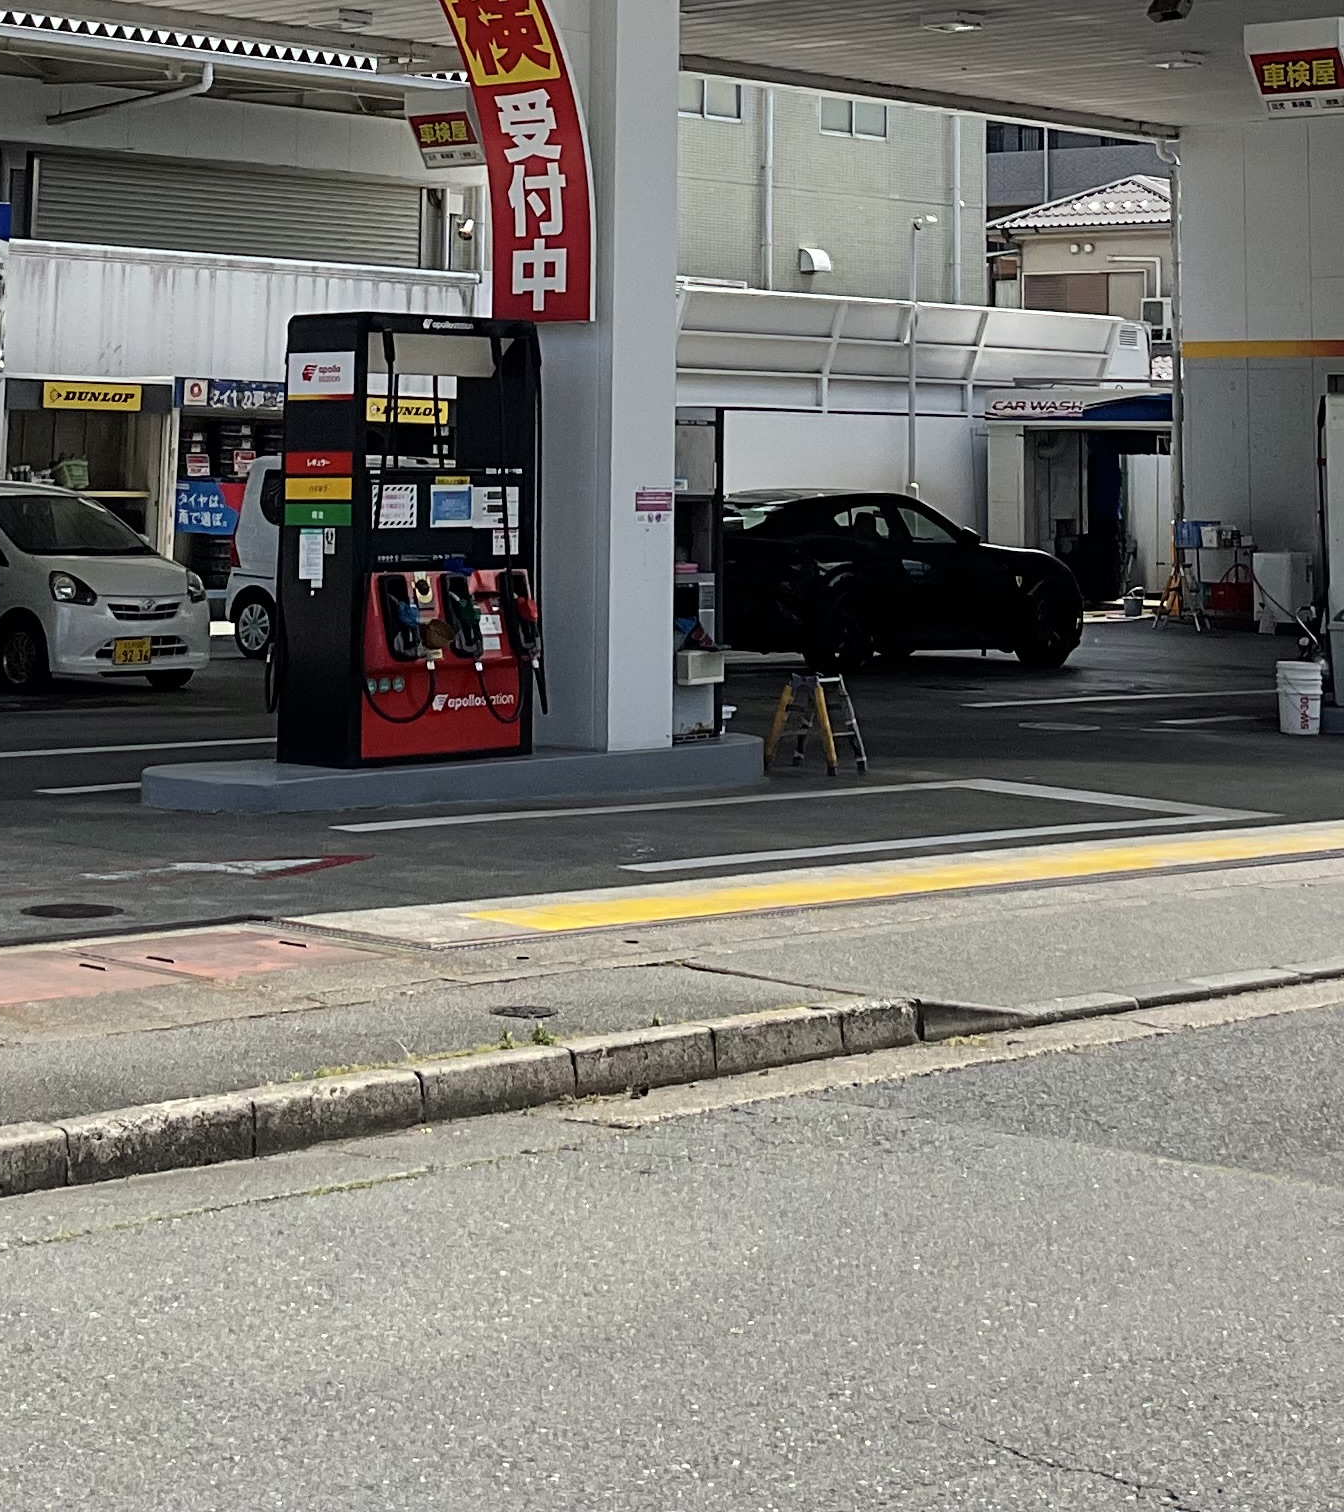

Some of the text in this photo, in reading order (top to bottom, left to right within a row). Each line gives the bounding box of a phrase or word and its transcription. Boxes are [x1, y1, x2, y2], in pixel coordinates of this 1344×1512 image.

[1262, 59, 1337, 90] 車検屋
[418, 120, 469, 144] 車検屋
[63, 390, 136, 404] DUNLOP
[991, 400, 1084, 412] CAR WASH
[448, 693, 515, 711] apollosation
